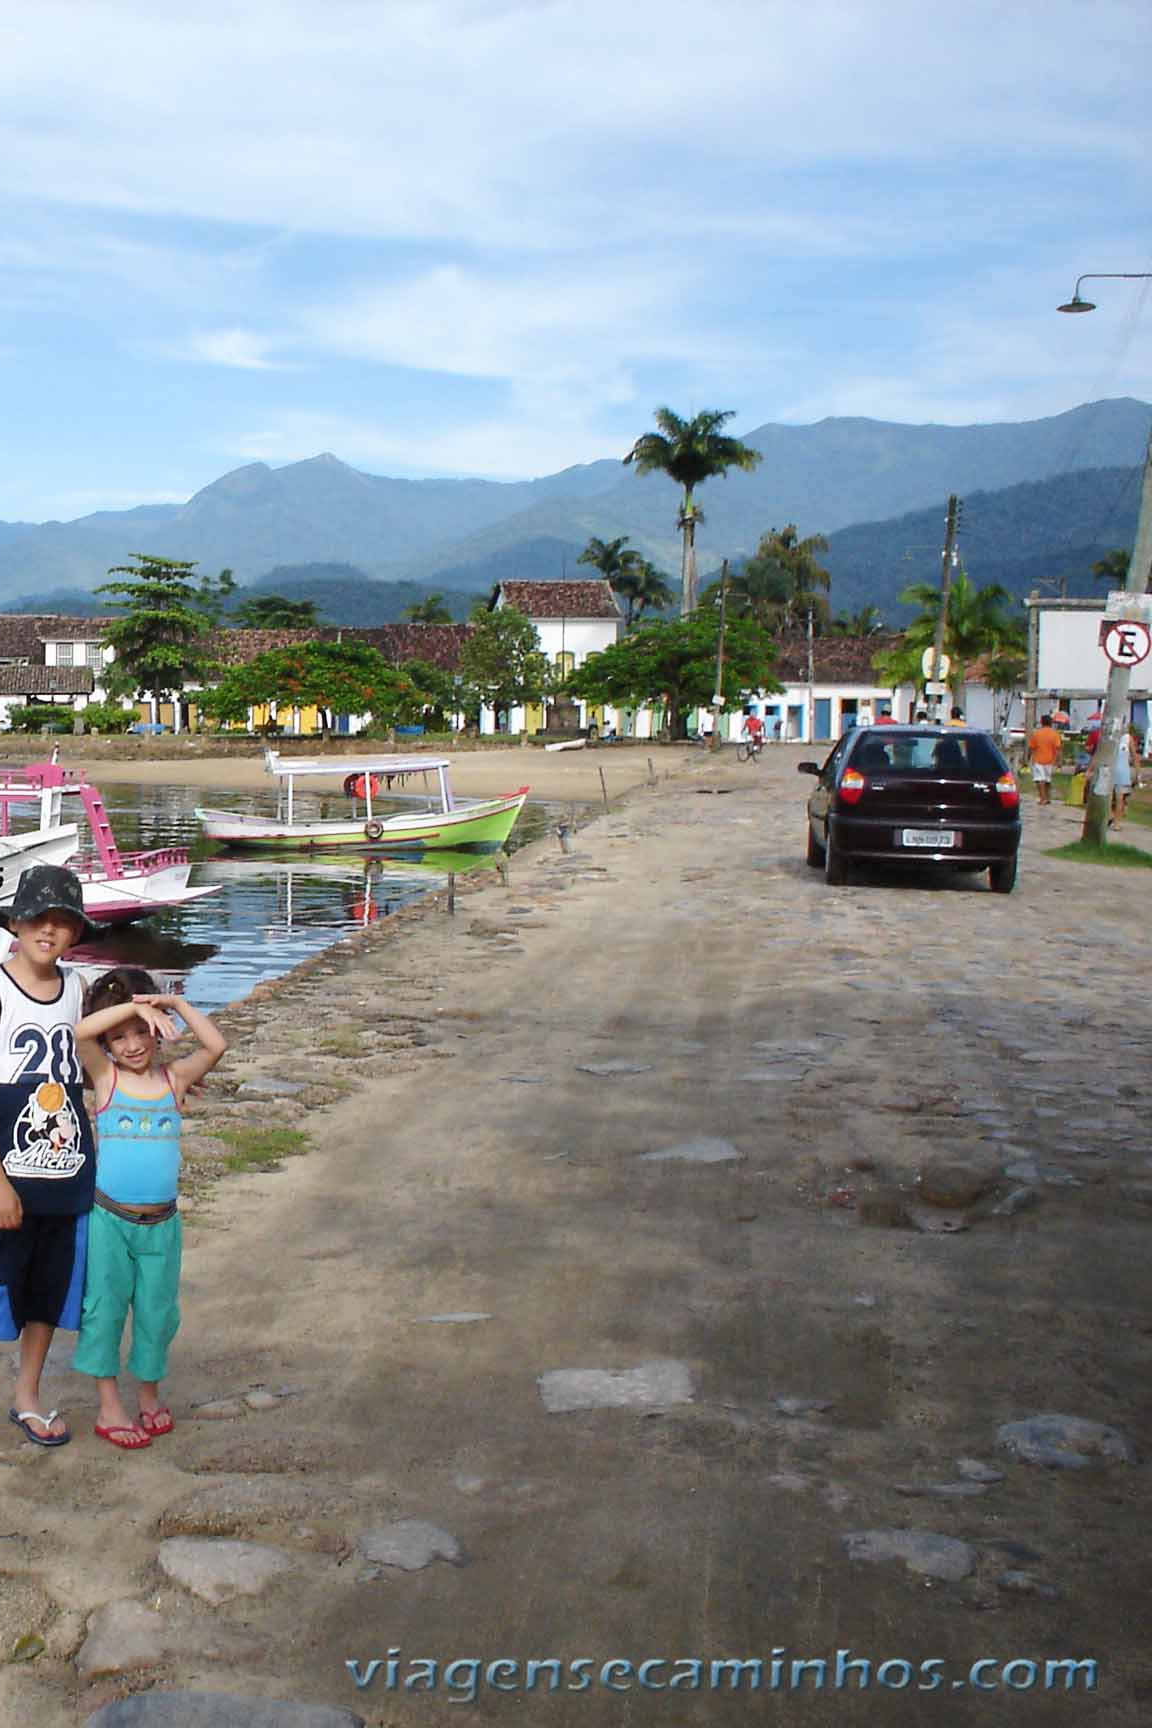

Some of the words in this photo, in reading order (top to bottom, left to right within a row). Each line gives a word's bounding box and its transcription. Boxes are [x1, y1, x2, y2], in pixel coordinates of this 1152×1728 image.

[1118, 630, 1136, 657] E
[9, 1022, 83, 1084] 28
[6, 1140, 84, 1171] Mickey
